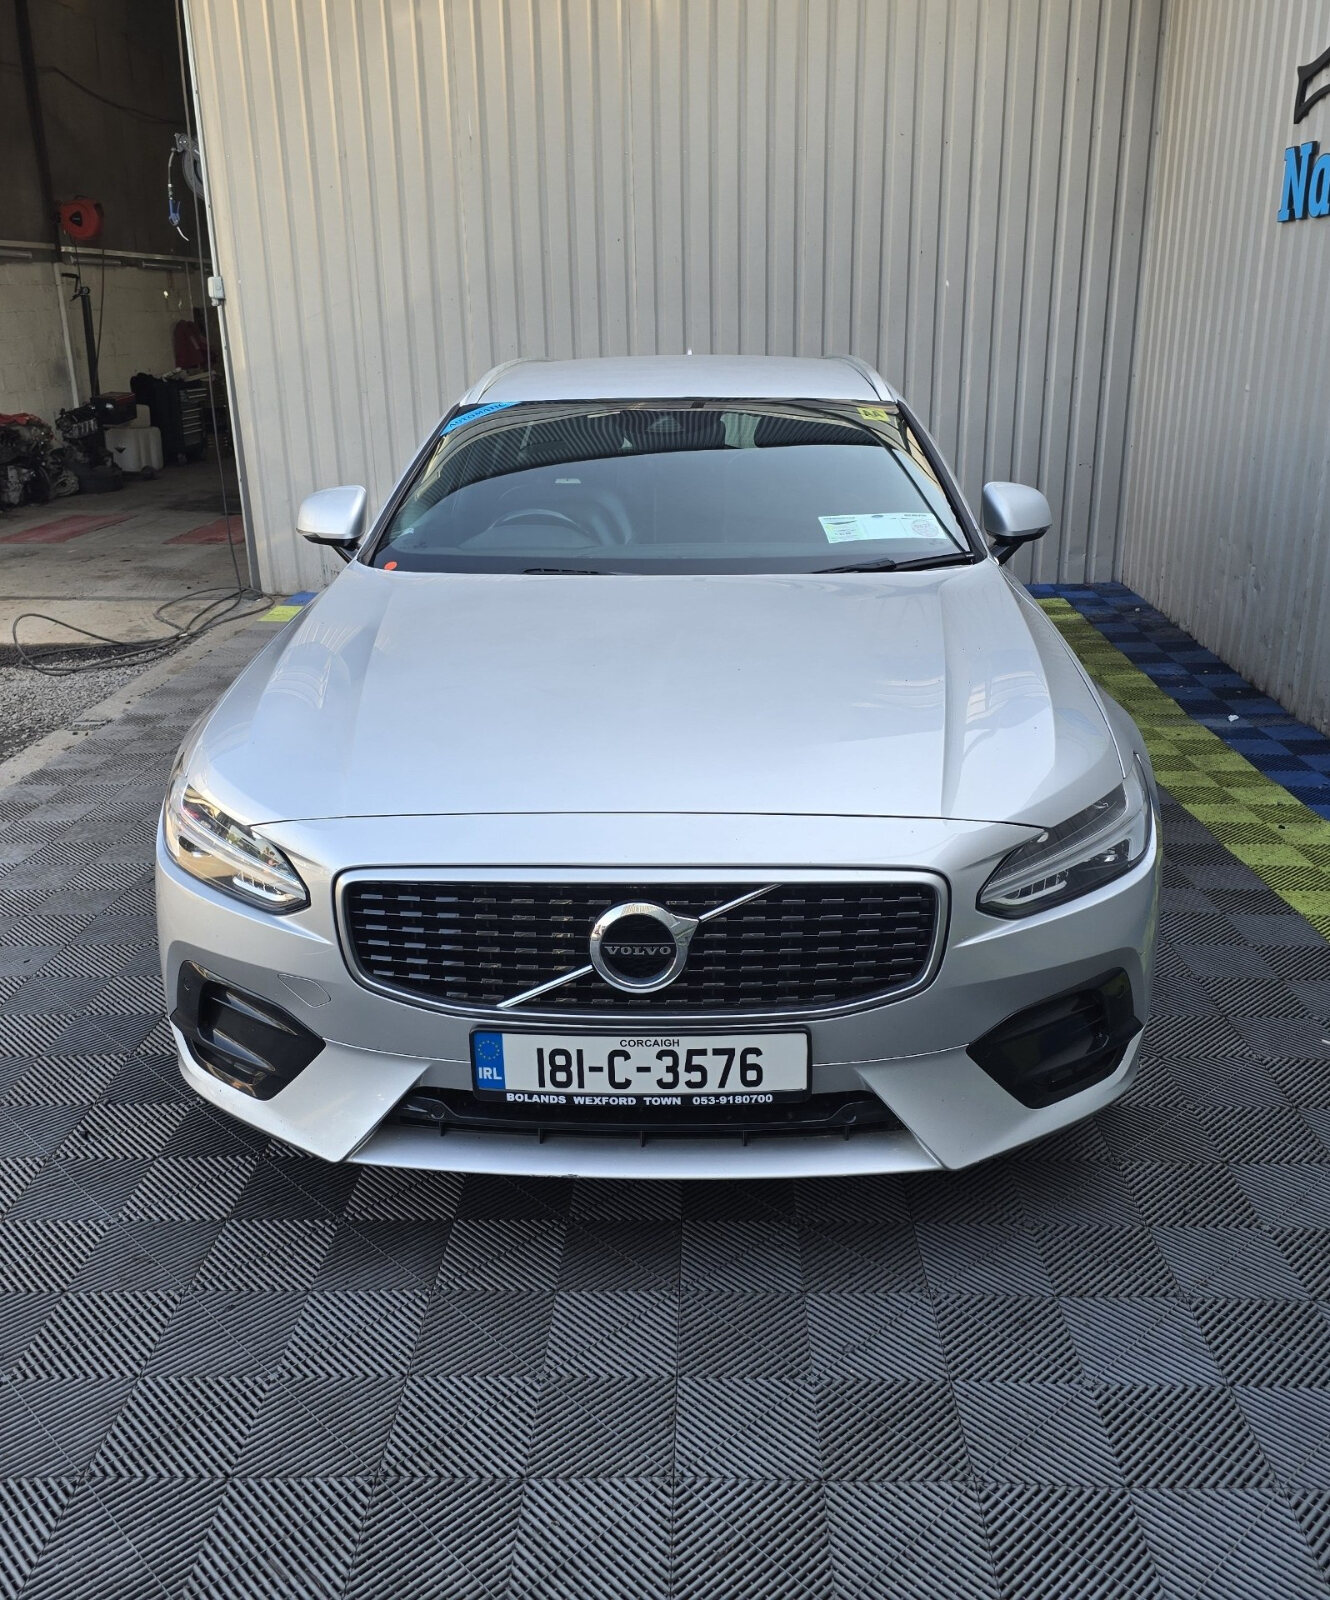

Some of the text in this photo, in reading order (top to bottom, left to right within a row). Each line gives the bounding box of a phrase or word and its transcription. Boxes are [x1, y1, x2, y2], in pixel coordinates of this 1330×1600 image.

[604, 946, 672, 956] VOLVO
[619, 1038, 680, 1048] CORCAIGH
[478, 1066, 502, 1080] IRL
[536, 1046, 764, 1090] 181-C-3576
[506, 1092, 773, 1106] BOLANDS WEXFORD TOWN 053-9180700
